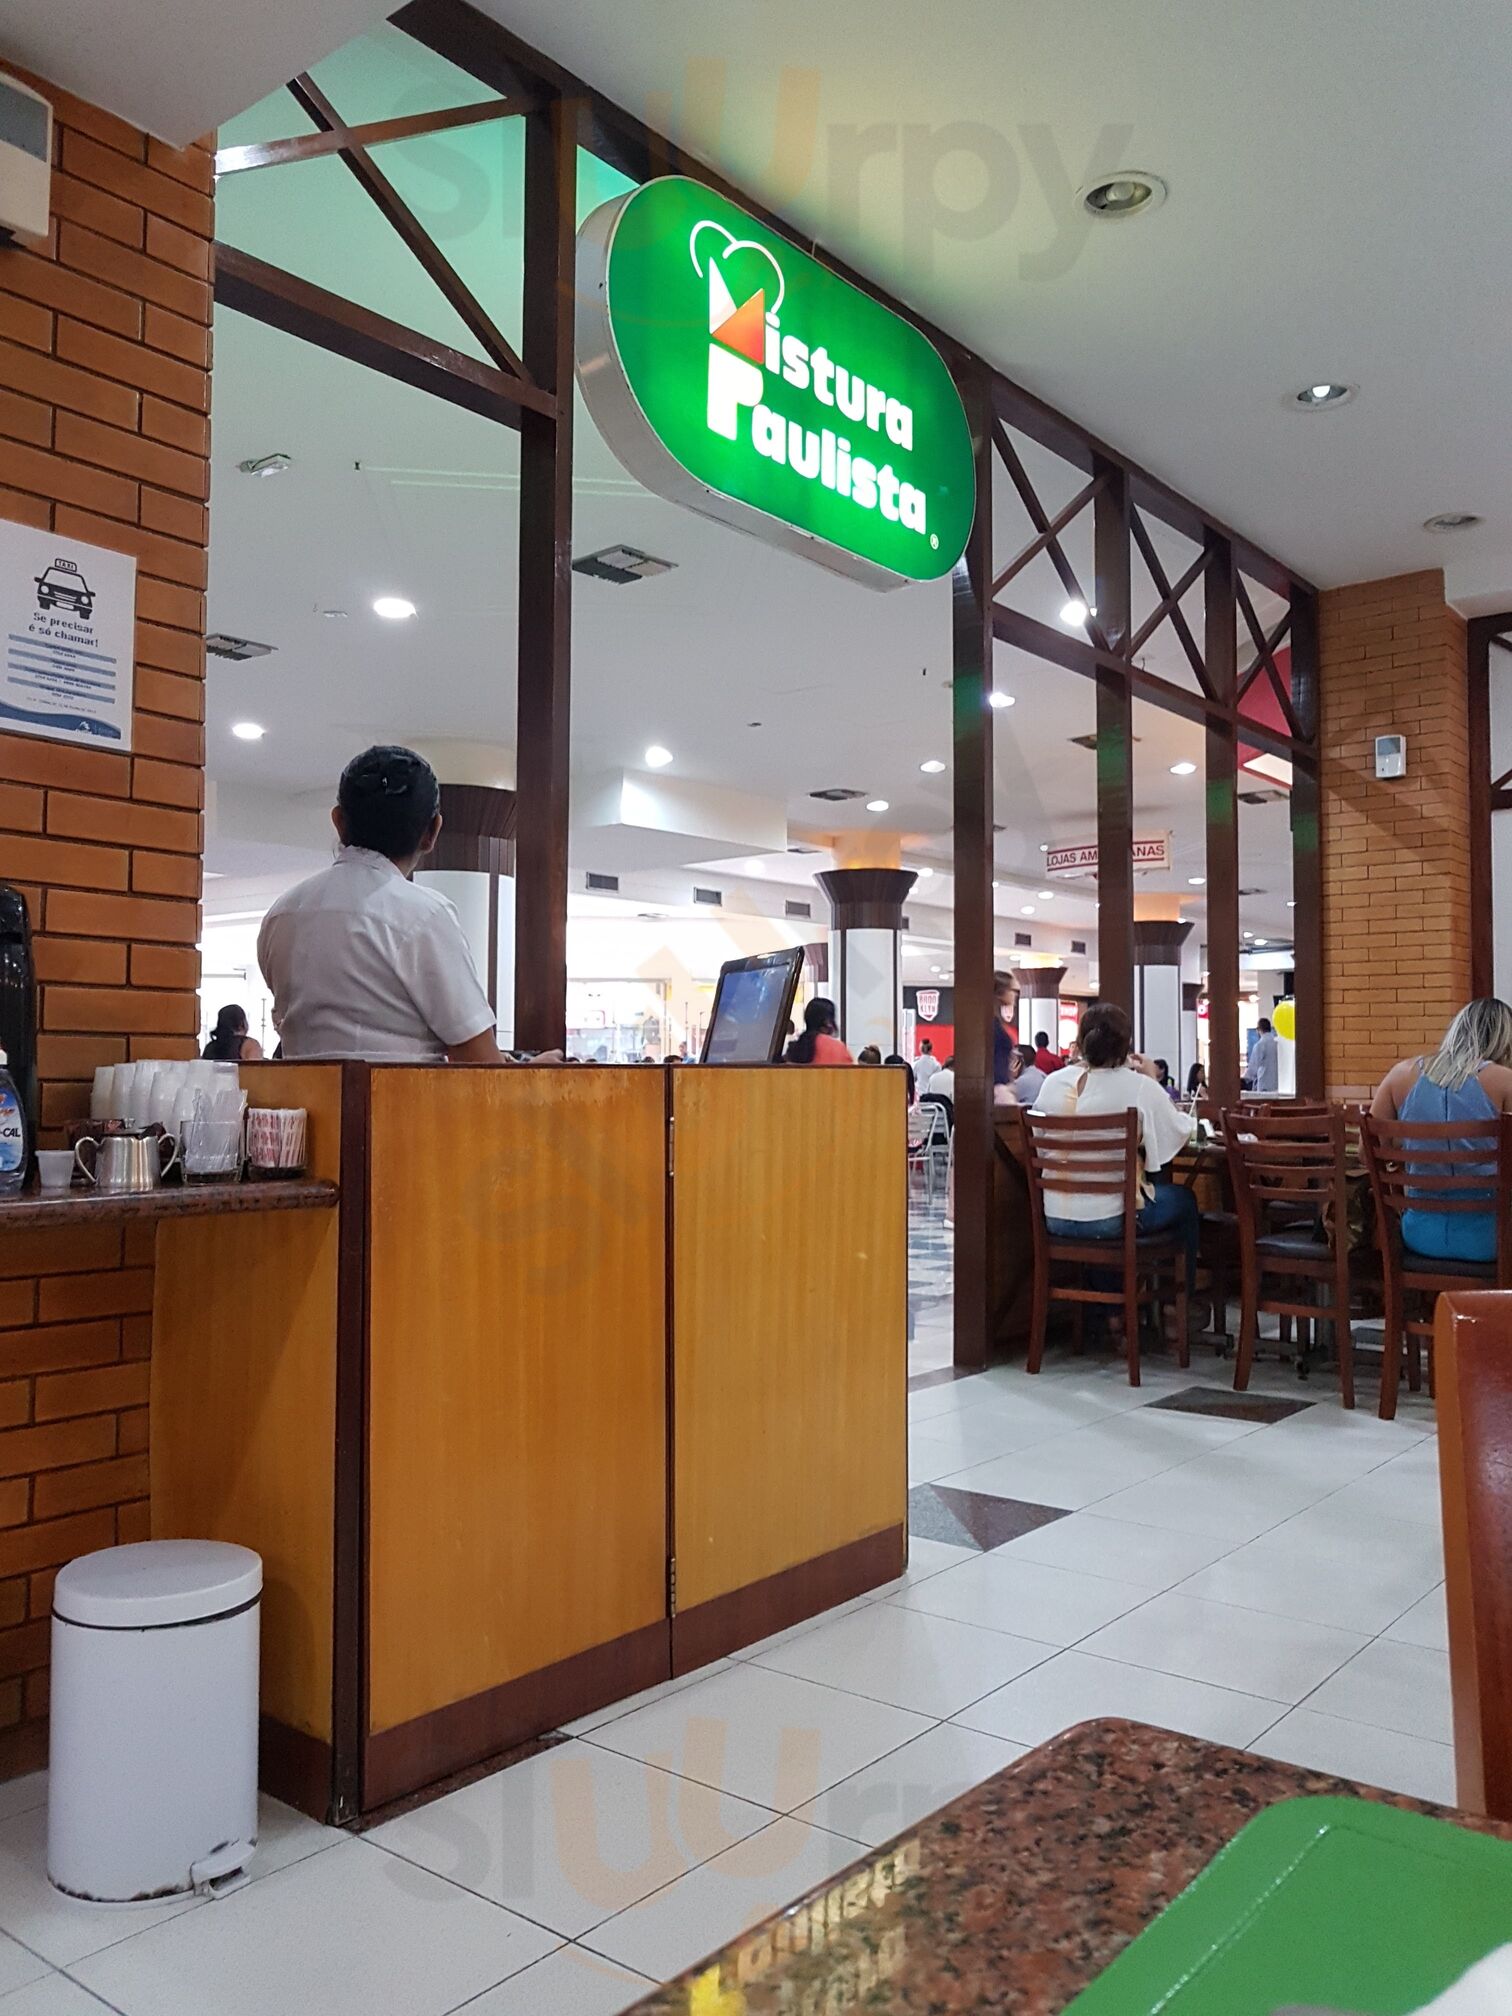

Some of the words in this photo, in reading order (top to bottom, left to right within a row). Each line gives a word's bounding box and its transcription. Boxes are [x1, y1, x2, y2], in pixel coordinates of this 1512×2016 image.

[708, 256, 914, 451] Mistura
[706, 343, 928, 536] Paulista
[57, 560, 76, 571] TAXI
[33, 611, 47, 624] Se
[50, 616, 94, 635] precisar
[28, 624, 36, 633] é
[38, 625, 52, 637] só
[54, 629, 99, 648] chamar!
[1047, 852, 1077, 868] LOJAS
[1080, 845, 1165, 863] AMNAS
